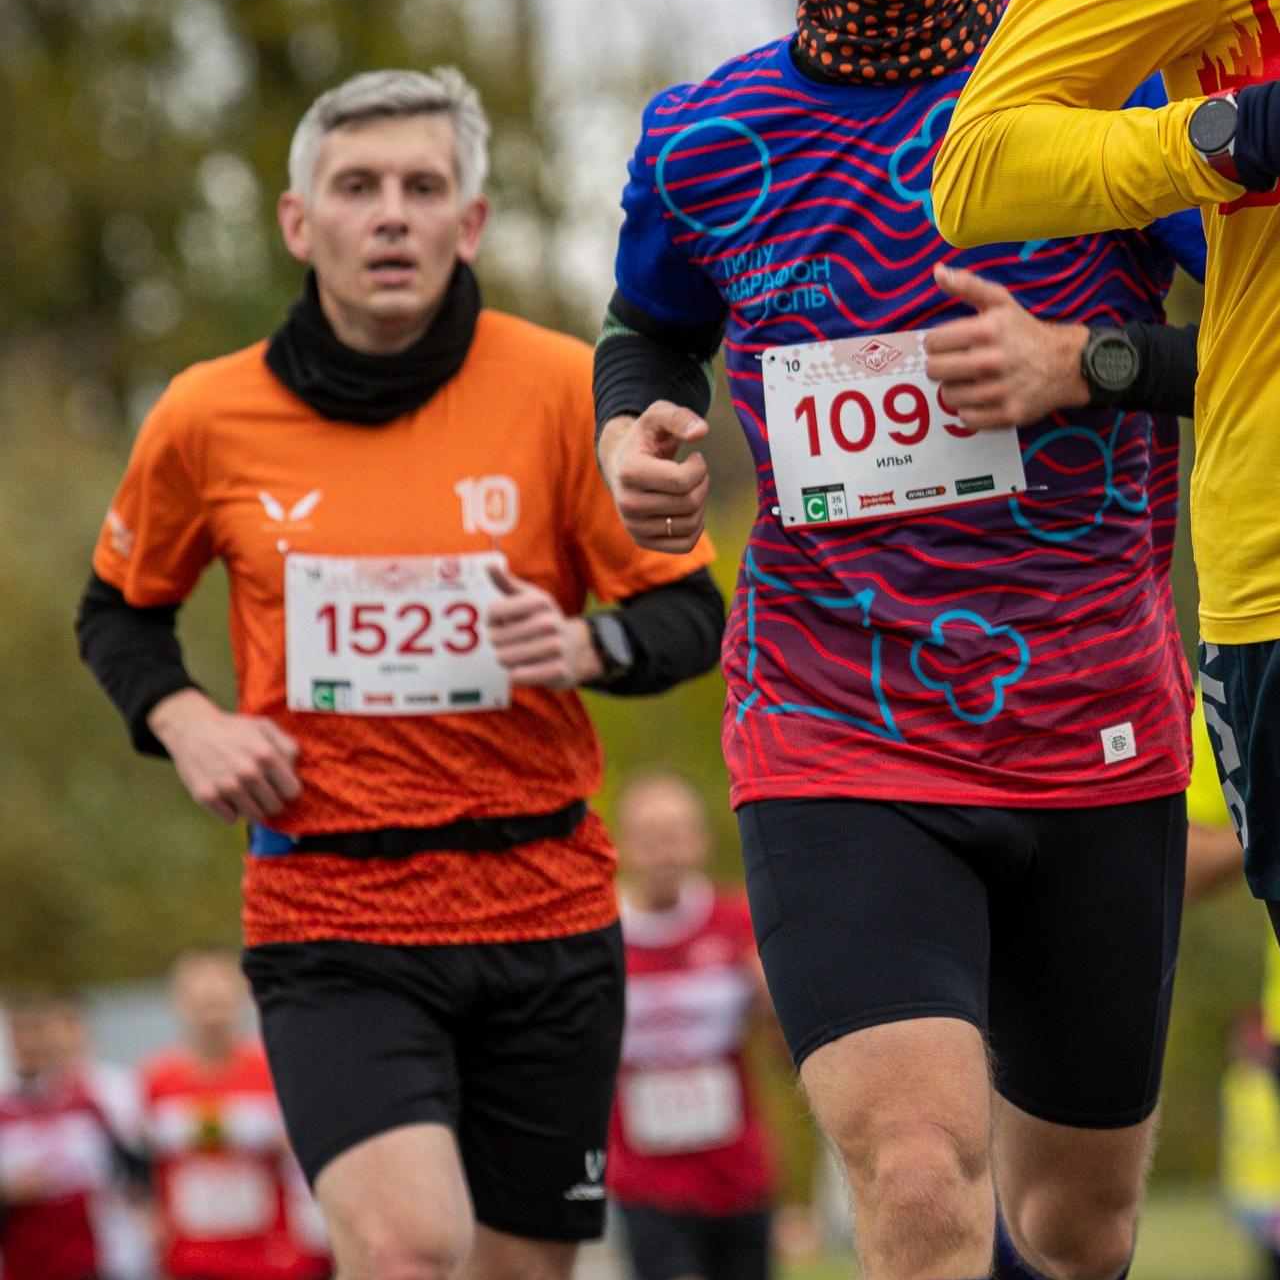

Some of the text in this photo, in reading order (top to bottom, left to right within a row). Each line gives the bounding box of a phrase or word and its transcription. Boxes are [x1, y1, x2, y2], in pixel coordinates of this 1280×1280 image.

[725, 256, 831, 302] МАРАФОН
[785, 359, 801, 373] 10
[876, 454, 913, 469] ИЛЬЯ
[830, 495, 842, 505] 35
[907, 487, 937, 500] WINLINE
[454, 474, 519, 536] 10
[832, 507, 844, 517] 39
[316, 602, 480, 657] 1523
